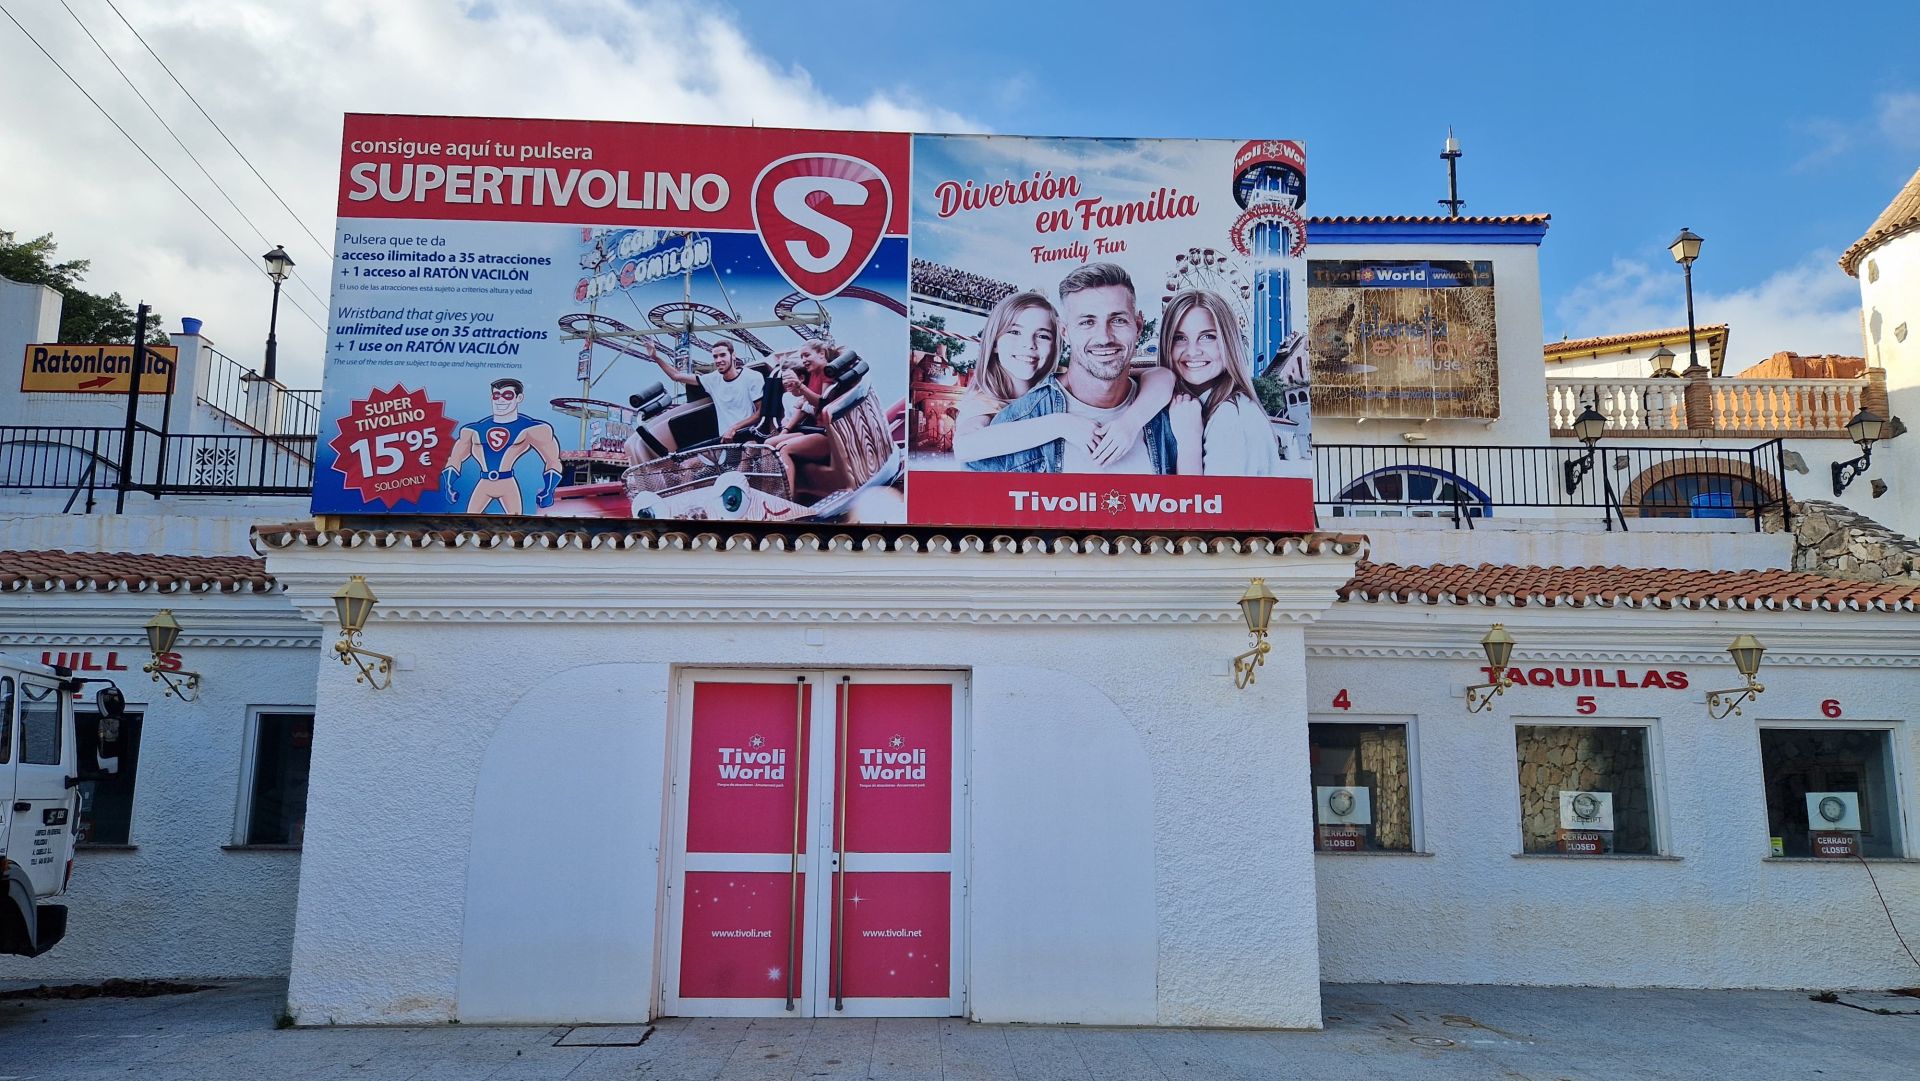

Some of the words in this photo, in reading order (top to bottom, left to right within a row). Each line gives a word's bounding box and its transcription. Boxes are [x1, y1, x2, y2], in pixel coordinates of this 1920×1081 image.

[350, 137, 441, 159] consigue
[445, 140, 490, 160] aquí
[495, 142, 515, 157] tu
[520, 141, 593, 161] pulsera
[348, 162, 730, 212] SUPERTIVOLINO
[935, 171, 1081, 218] Diversión
[1036, 208, 1073, 233] en
[1075, 188, 1199, 231] Familia
[774, 176, 868, 273] S
[343, 233, 387, 245] Pulsera
[389, 236, 413, 248] que
[416, 236, 428, 246] te
[430, 235, 446, 246] da
[341, 251, 385, 261] acceso
[387, 250, 446, 262] ilimitado
[448, 254, 456, 262] a
[459, 252, 475, 263] 35
[477, 253, 552, 265] atracciones
[1031, 240, 1090, 264] Family
[1094, 237, 1127, 255] Fun
[341, 268, 349, 276] +
[353, 266, 359, 277] 1
[363, 268, 406, 278] acceso
[408, 267, 420, 278] al
[423, 266, 469, 279] RATÓN
[471, 268, 529, 281] VACILÓN
[1376, 270, 1425, 281] World
[360, 283, 369, 291] de
[380, 284, 418, 292] atracciones
[434, 285, 455, 293] sujeto
[461, 286, 488, 294] criterios
[489, 286, 509, 294] altura
[515, 287, 533, 295] edad
[338, 306, 404, 320] Wristband
[406, 308, 433, 320] that
[435, 309, 468, 324] gives
[469, 312, 494, 325] you
[336, 323, 404, 336] unlimited
[405, 326, 429, 336] use
[431, 327, 449, 337] on
[452, 325, 470, 338] 35
[472, 327, 548, 340] attractions
[334, 342, 344, 351] +
[348, 340, 355, 351] 1
[358, 342, 383, 352] use
[384, 343, 403, 352] on
[405, 339, 455, 353] RATÓN
[458, 340, 520, 355] VACILÓN
[333, 358, 345, 366] The
[406, 360, 429, 368] subject
[466, 361, 486, 369] height
[364, 397, 412, 417] SUPER
[355, 409, 425, 432] TIVOLINO
[488, 431, 506, 448] S
[374, 475, 426, 493] SOLO/ONLY
[1009, 490, 1097, 512] Tivoli
[1130, 492, 1223, 514] World
[1481, 666, 1689, 690] TAQUILLAS
[1332, 688, 1351, 710] 4
[1576, 696, 1597, 714] 5
[1821, 699, 1842, 718] 6
[719, 747, 785, 764] Tivoli
[860, 748, 925, 764] Tivoli
[718, 765, 784, 780] World
[860, 765, 925, 780] World
[1324, 839, 1356, 847] CLOSED
[1561, 833, 1599, 841] CERRADO
[1817, 837, 1853, 845] CERRADO
[1567, 843, 1596, 851] CLOSED
[1821, 846, 1851, 854] CLOSED
[711, 928, 772, 938] www.tivoli.net
[862, 928, 922, 938] www.tivoli.net
